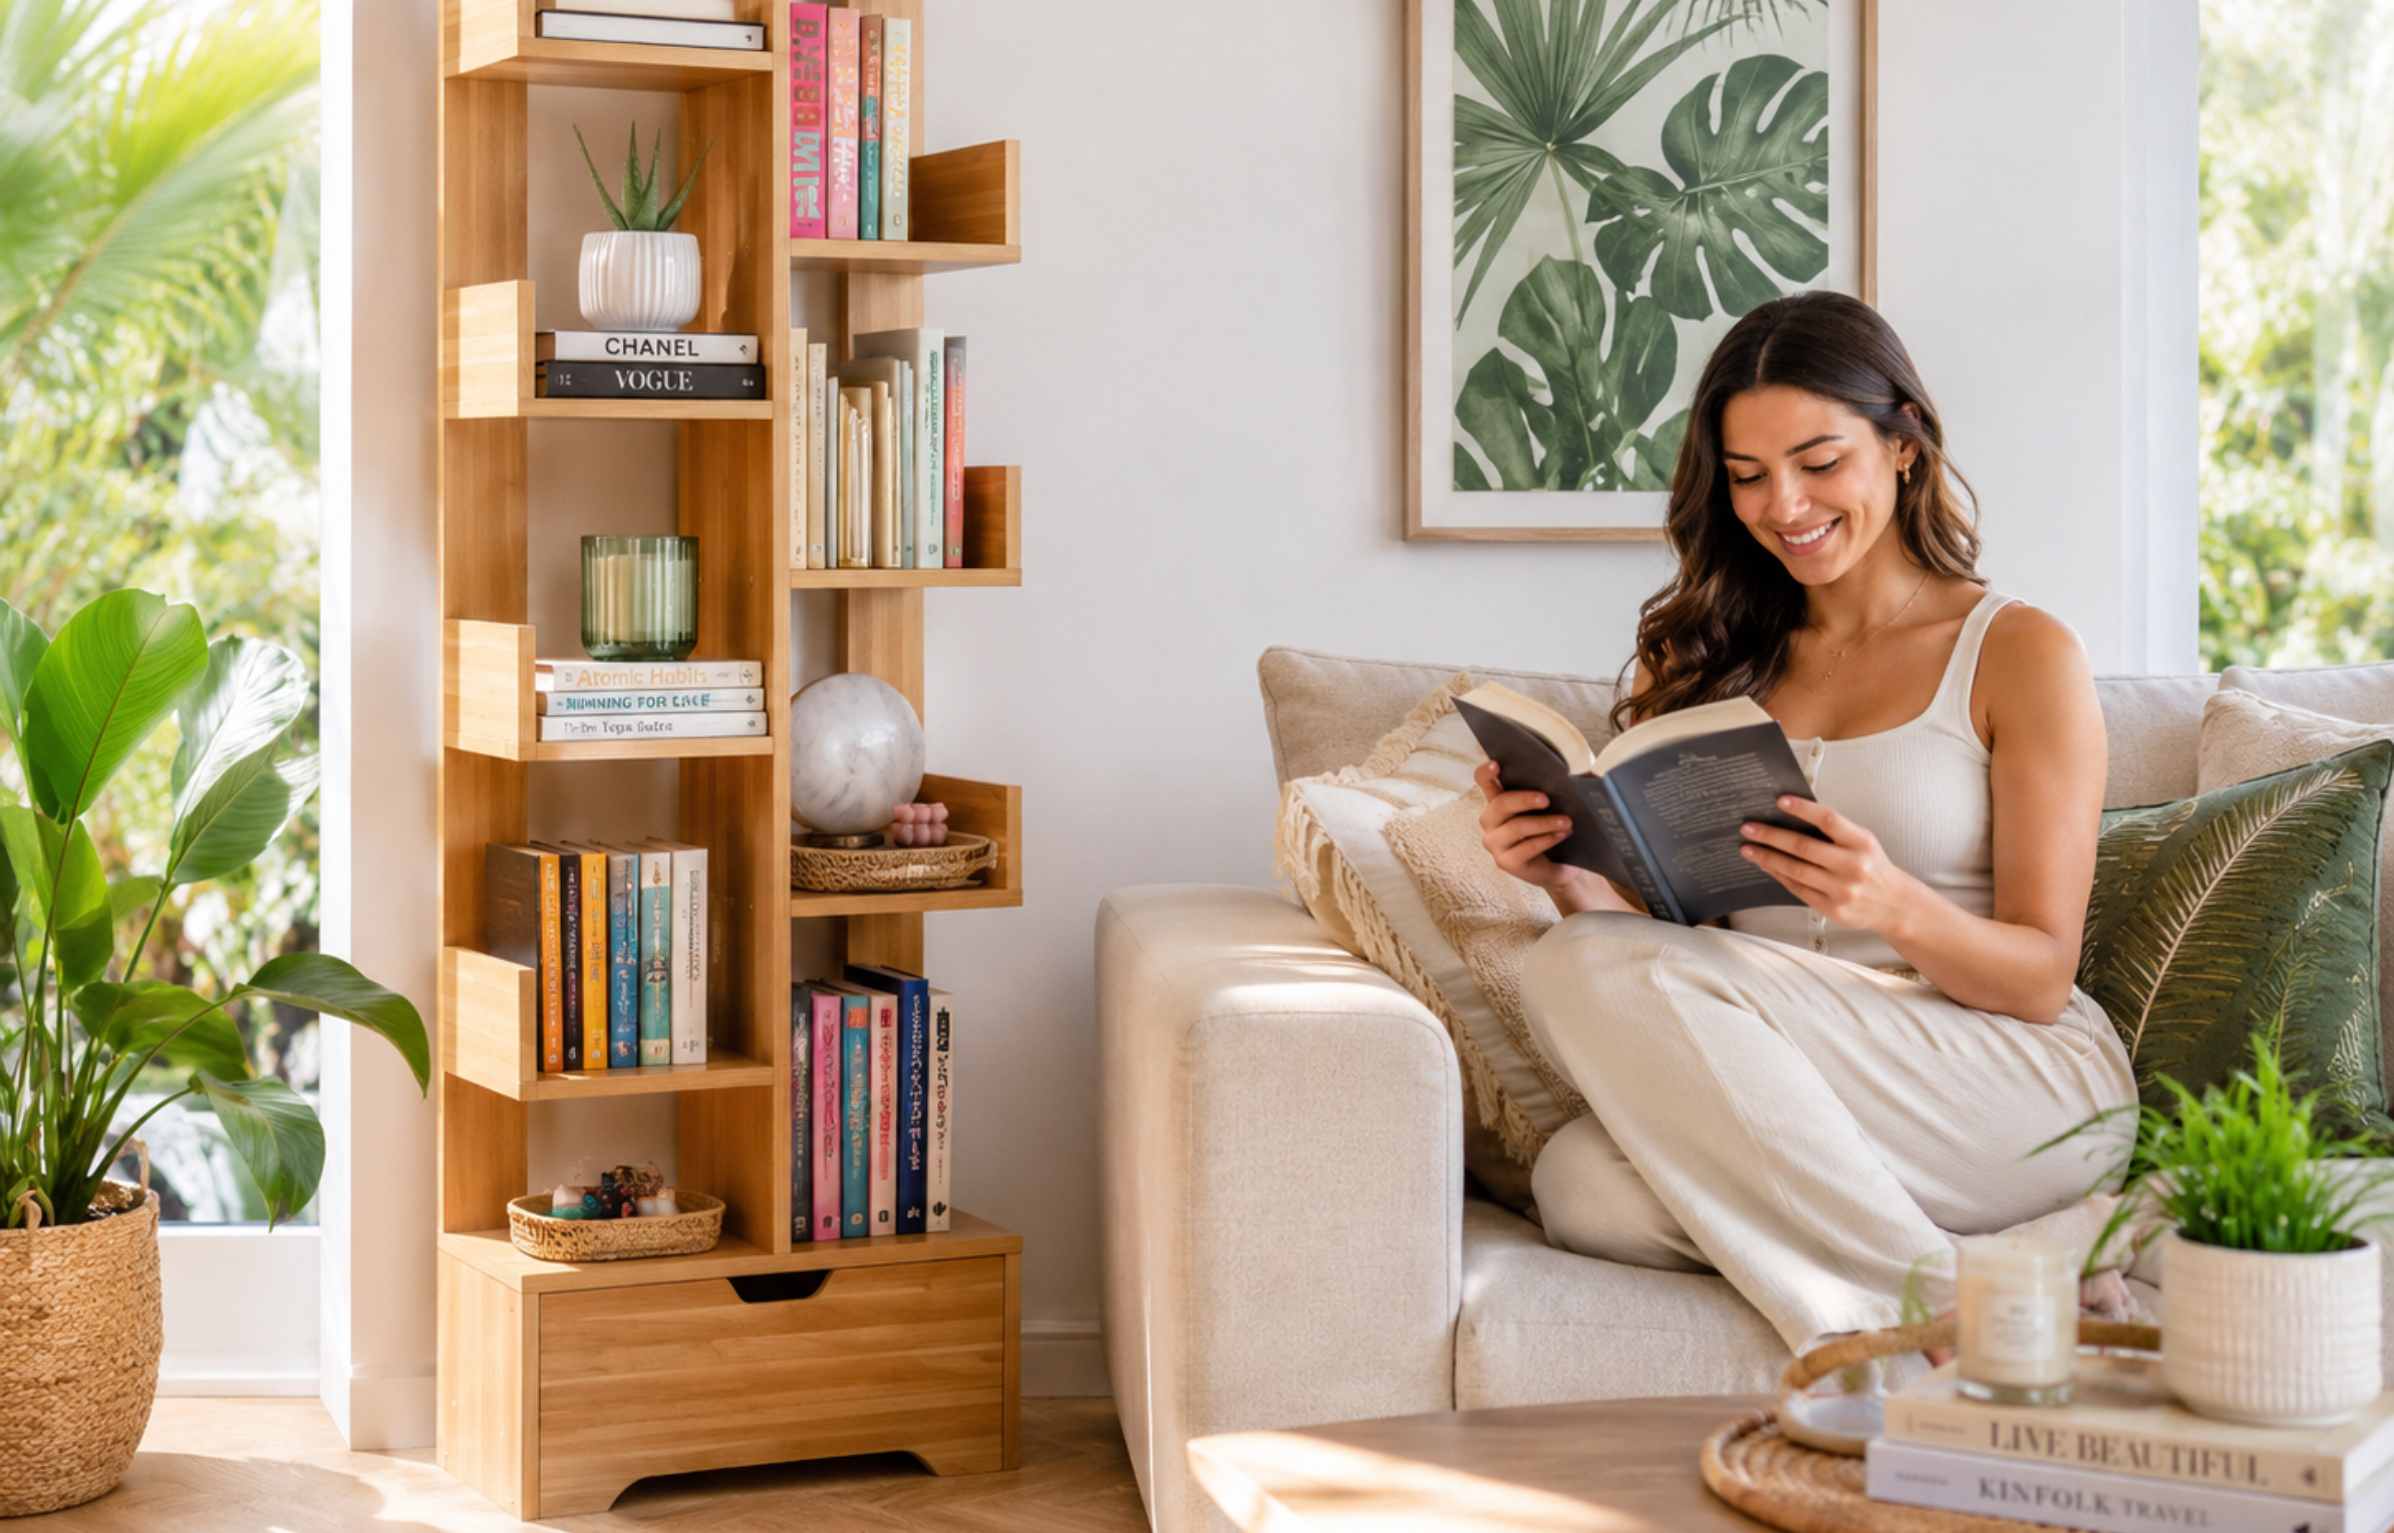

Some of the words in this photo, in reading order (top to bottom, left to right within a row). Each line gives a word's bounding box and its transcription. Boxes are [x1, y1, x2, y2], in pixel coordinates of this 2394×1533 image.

[605, 337, 699, 357] CHANEL
[615, 369, 693, 391] VOGUE
[576, 669, 643, 688] Atomic
[650, 667, 708, 687] Habits
[637, 696, 667, 709] FOR
[1990, 1421, 2068, 1458] LIVE
[2076, 1433, 2270, 1487] BEAUTIFUL
[1978, 1477, 2112, 1516] KINFOLK
[2119, 1499, 2214, 1527] TRAVEL
